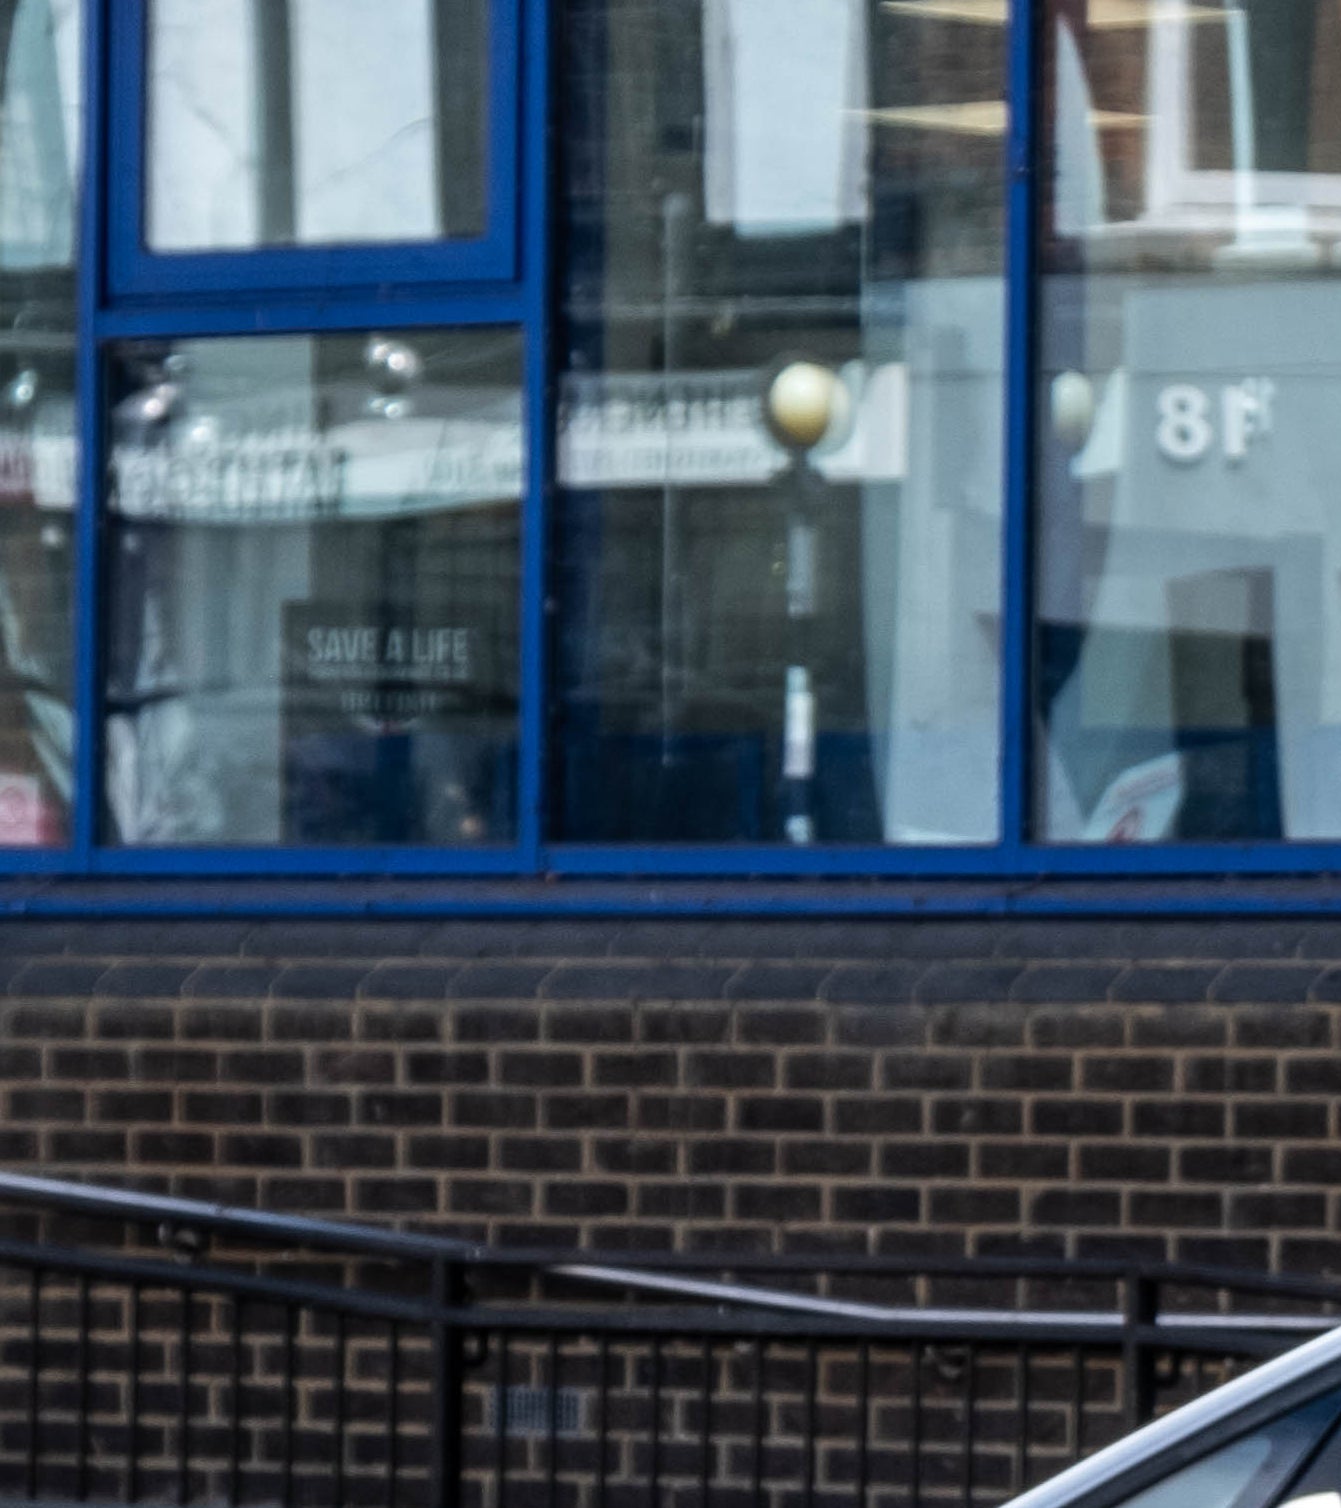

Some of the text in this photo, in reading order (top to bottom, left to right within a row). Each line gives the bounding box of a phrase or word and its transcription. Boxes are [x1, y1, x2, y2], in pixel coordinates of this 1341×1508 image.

[306, 626, 470, 662] SAVE A LIFE
